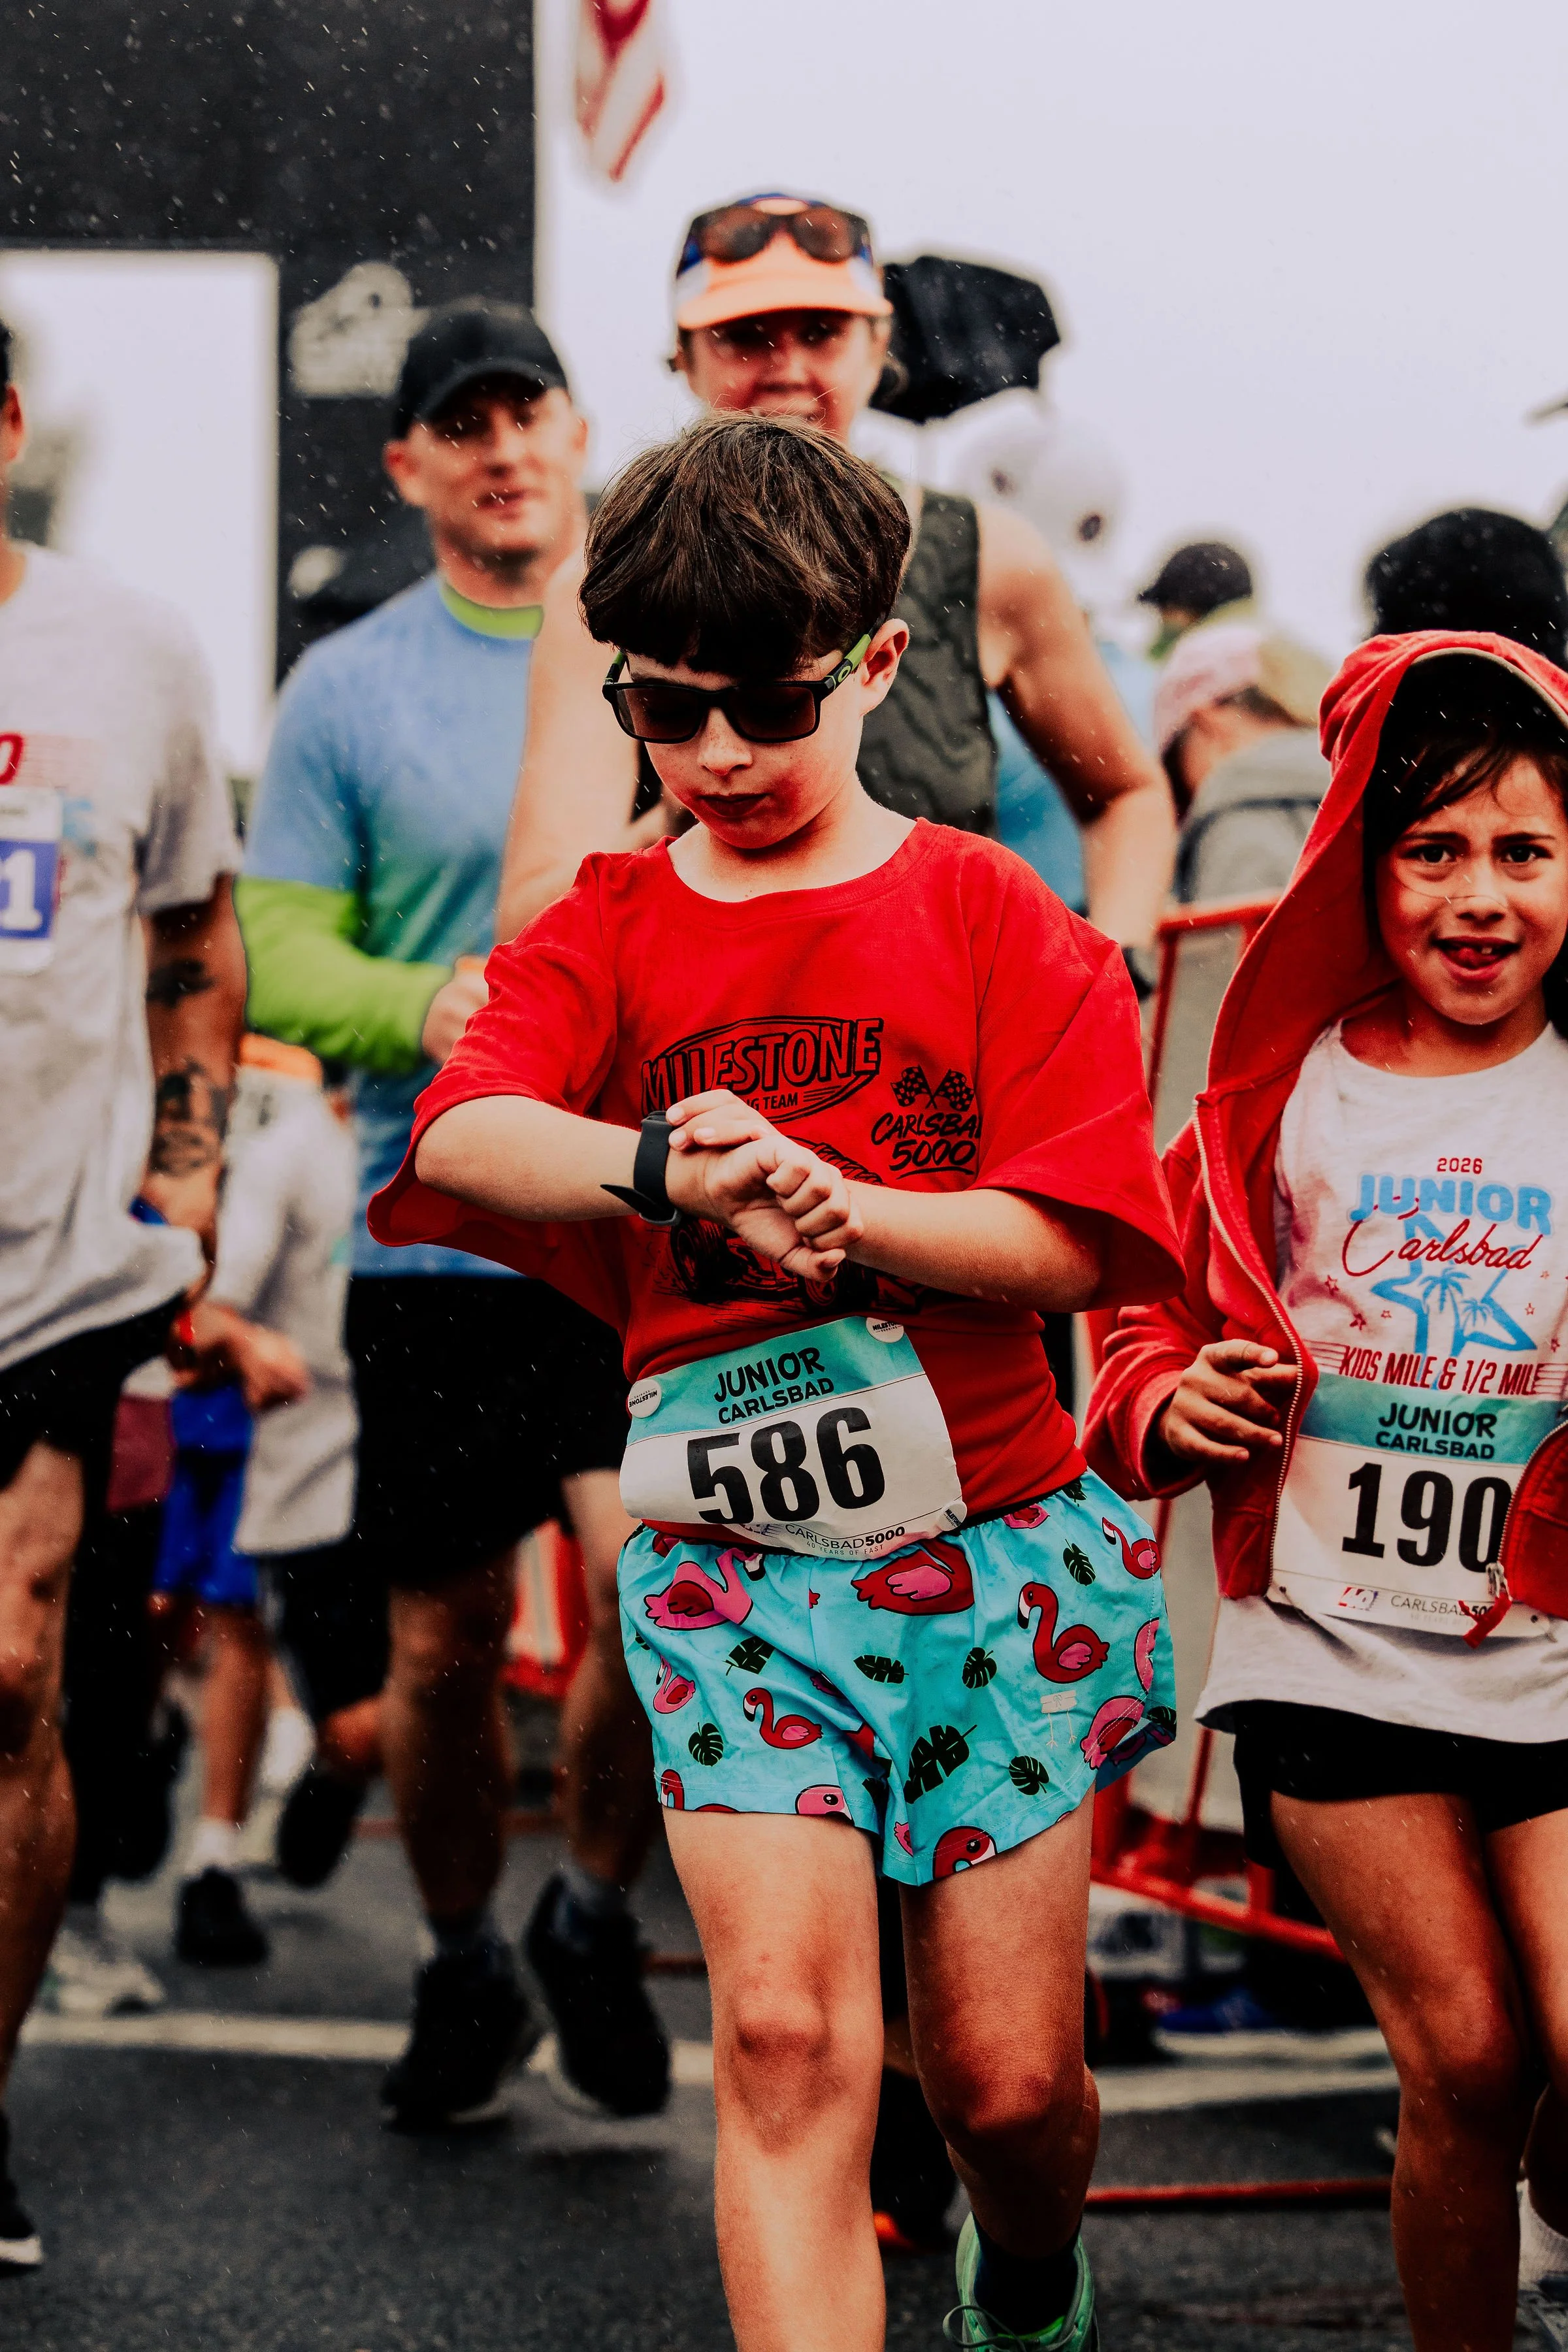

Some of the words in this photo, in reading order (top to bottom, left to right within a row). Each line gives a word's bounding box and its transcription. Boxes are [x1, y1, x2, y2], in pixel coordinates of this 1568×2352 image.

[640, 1018, 884, 1117] MILESTONE
[763, 1092, 798, 1110] TEAM
[889, 1139, 976, 1171] 5000
[1437, 1158, 1483, 1175] 2026
[1350, 1175, 1552, 1236] JUNIOR
[1341, 1196, 1544, 1277] Carlsbad
[713, 1347, 826, 1403] JUNIOR
[1339, 1346, 1382, 1381] KIDS
[1382, 1352, 1438, 1389] MILE
[1438, 1358, 1458, 1390] &
[1461, 1359, 1497, 1394] 1/2
[629, 1390, 657, 1408] MILESTONE
[719, 1377, 835, 1424] CARLSBAD
[1379, 1403, 1497, 1438] JUNIOR
[687, 1407, 885, 1525] 586
[1375, 1431, 1495, 1460] CARLSBAD
[785, 1526, 906, 1549] CARLSBAD5000
[1342, 1462, 1512, 1573] 190
[820, 1546, 844, 1556] YEARS
[864, 1544, 883, 1554] FAST
